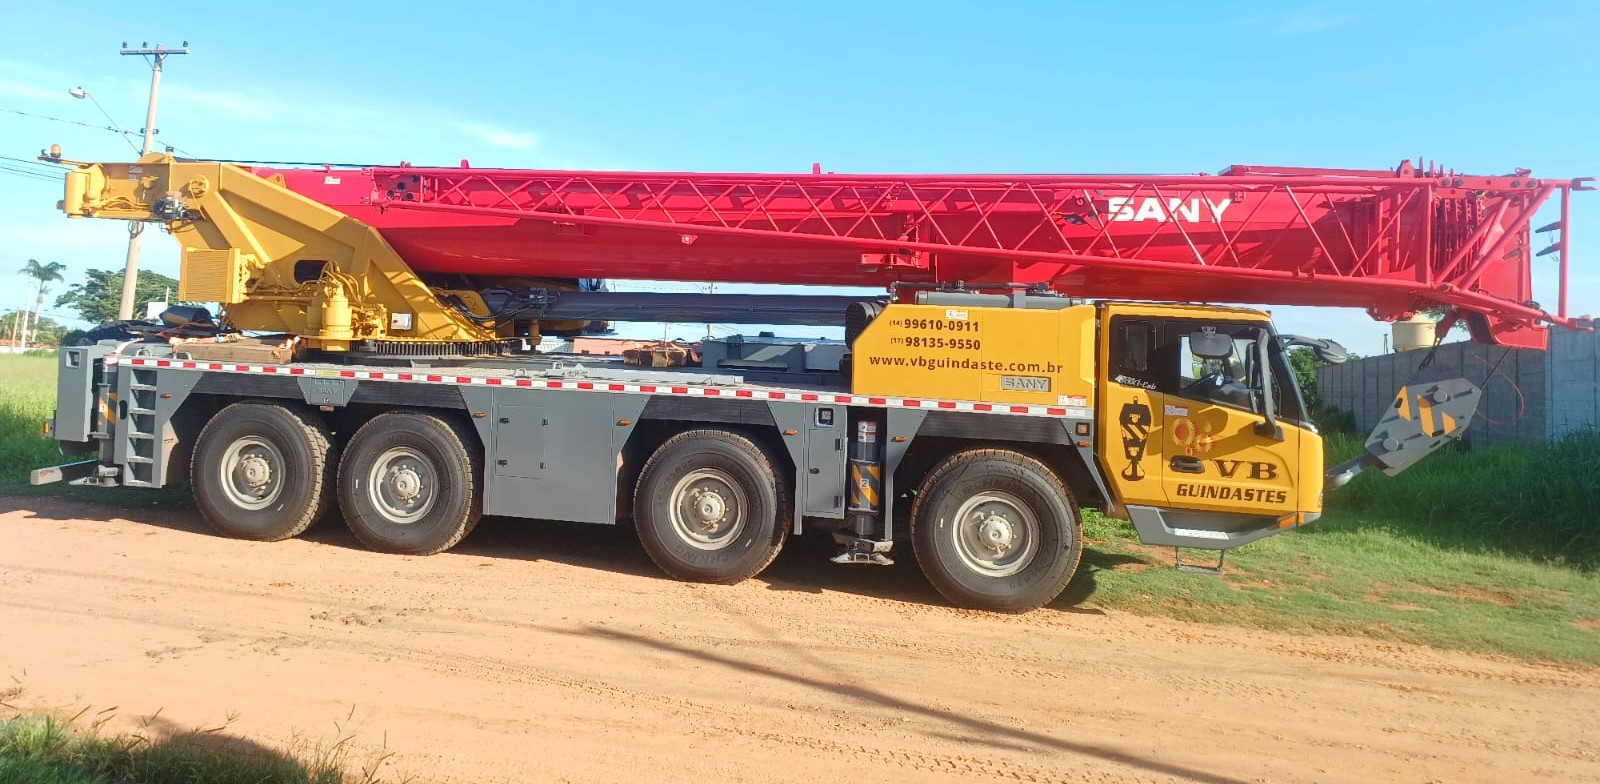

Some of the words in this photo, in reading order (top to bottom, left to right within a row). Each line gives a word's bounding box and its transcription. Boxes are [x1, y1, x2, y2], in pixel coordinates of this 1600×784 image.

[1108, 196, 1232, 223] SANY
[904, 318, 979, 332] 99610-0911
[905, 336, 981, 351] 98135-9550
[869, 355, 1064, 374] www.vbguindaste.com.br
[1005, 377, 1047, 389] SANY
[1209, 458, 1280, 480] VB
[1176, 483, 1287, 504] GUINDASTES
